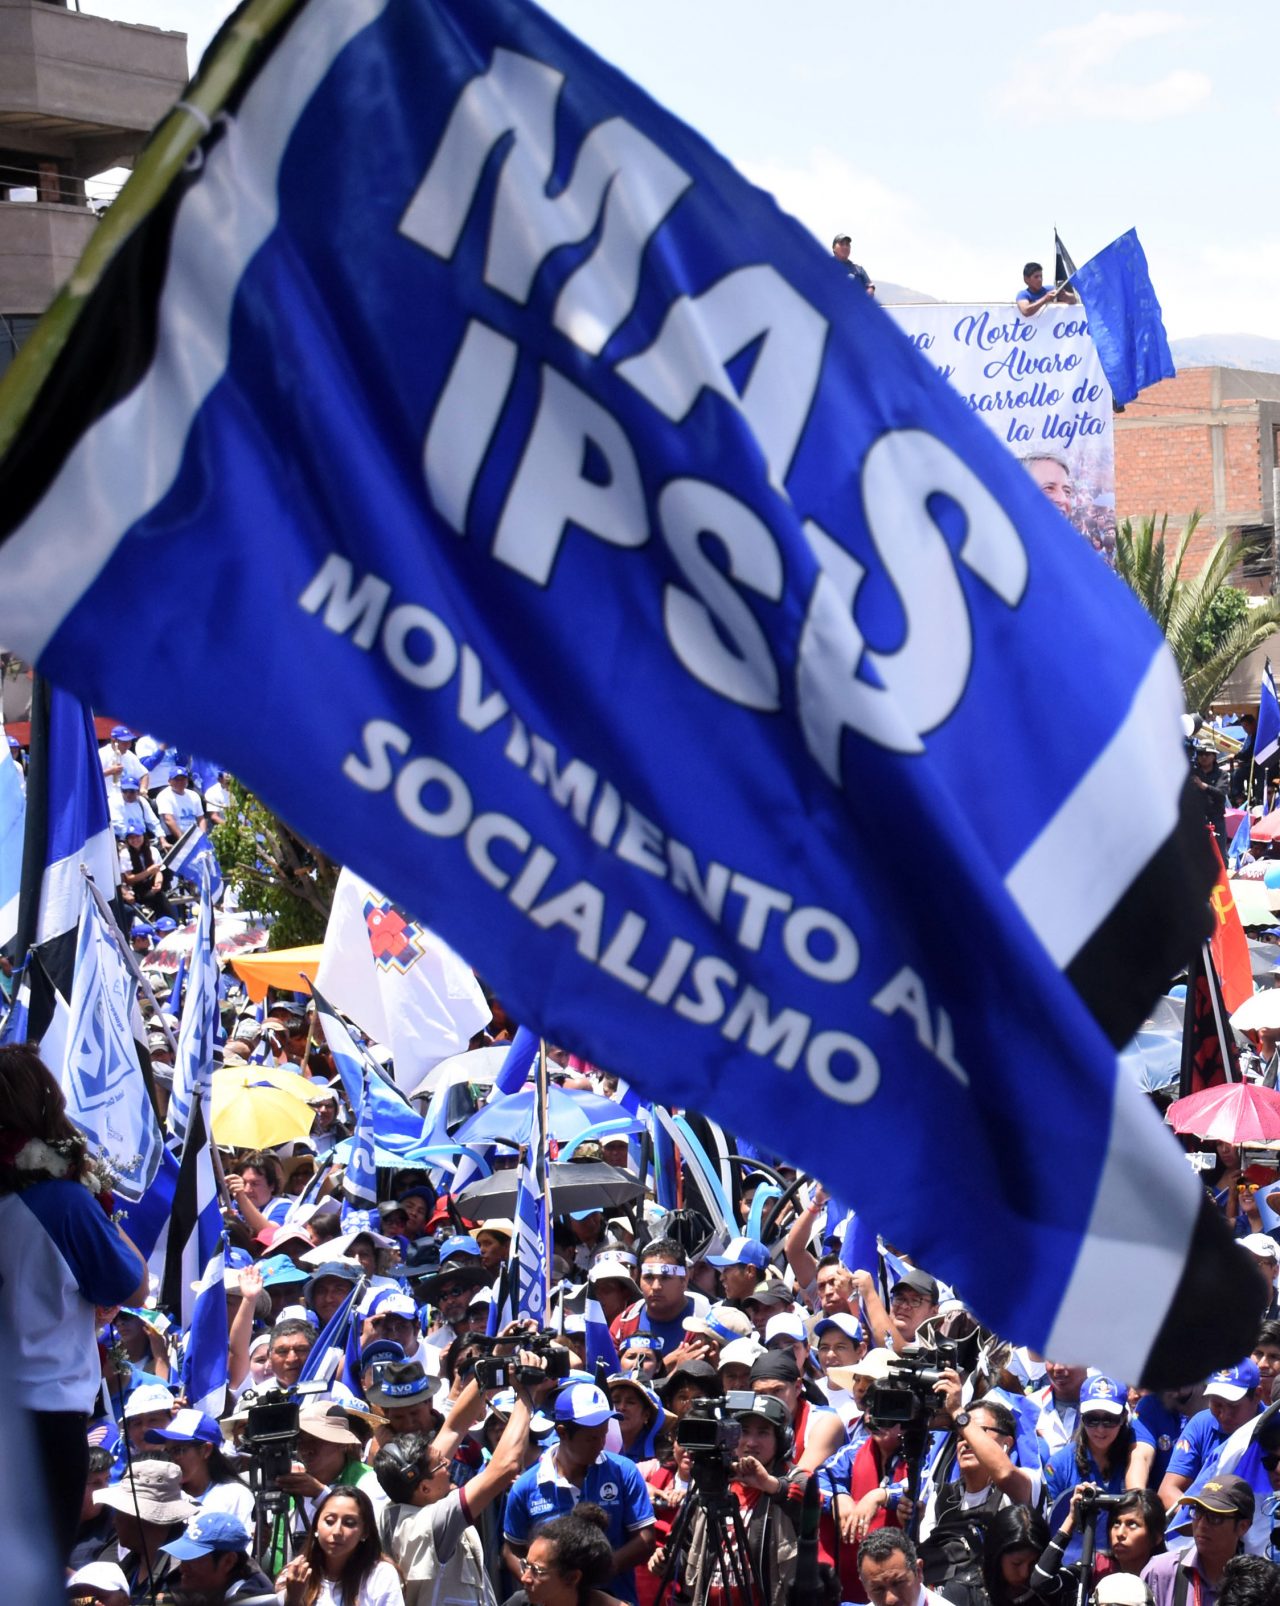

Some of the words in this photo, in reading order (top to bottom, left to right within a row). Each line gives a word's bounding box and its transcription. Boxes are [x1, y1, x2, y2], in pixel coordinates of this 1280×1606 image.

[953, 311, 1038, 350] Norte
[983, 347, 1082, 381] Alvaro
[399, 47, 1028, 753] MAS
[1072, 378, 1104, 404] de
[1006, 418, 1034, 442] la
[1041, 411, 1106, 449] llajta
[423, 318, 895, 787] IPS
[300, 553, 860, 984] MOVIMIENTO
[342, 719, 881, 1105] SOCIALISMO
[390, 1383, 412, 1392] EVO
